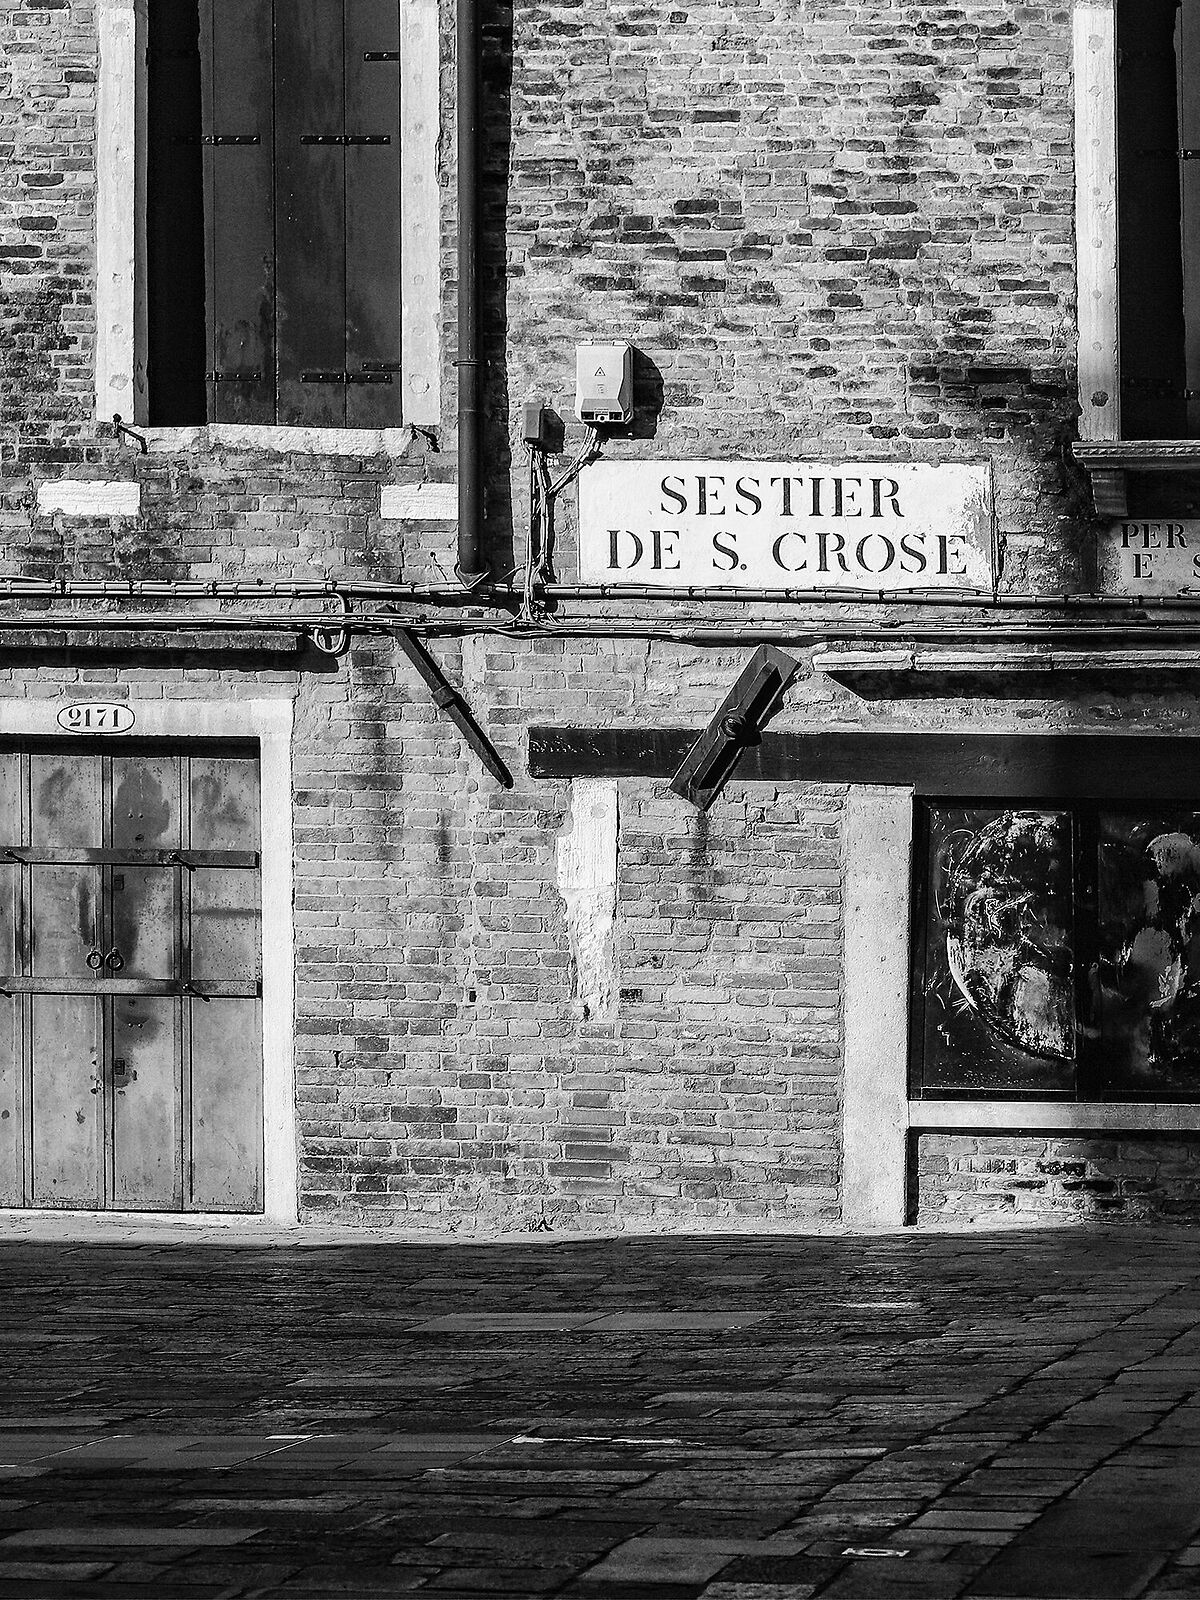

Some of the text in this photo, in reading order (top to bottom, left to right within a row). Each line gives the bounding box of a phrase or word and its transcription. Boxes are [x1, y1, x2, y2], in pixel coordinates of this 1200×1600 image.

[661, 475, 905, 518] SESTIER
[1121, 523, 1188, 549] PER
[606, 530, 967, 575] DE S. CROSE
[1132, 553, 1153, 579] E
[68, 708, 119, 728] 2171
